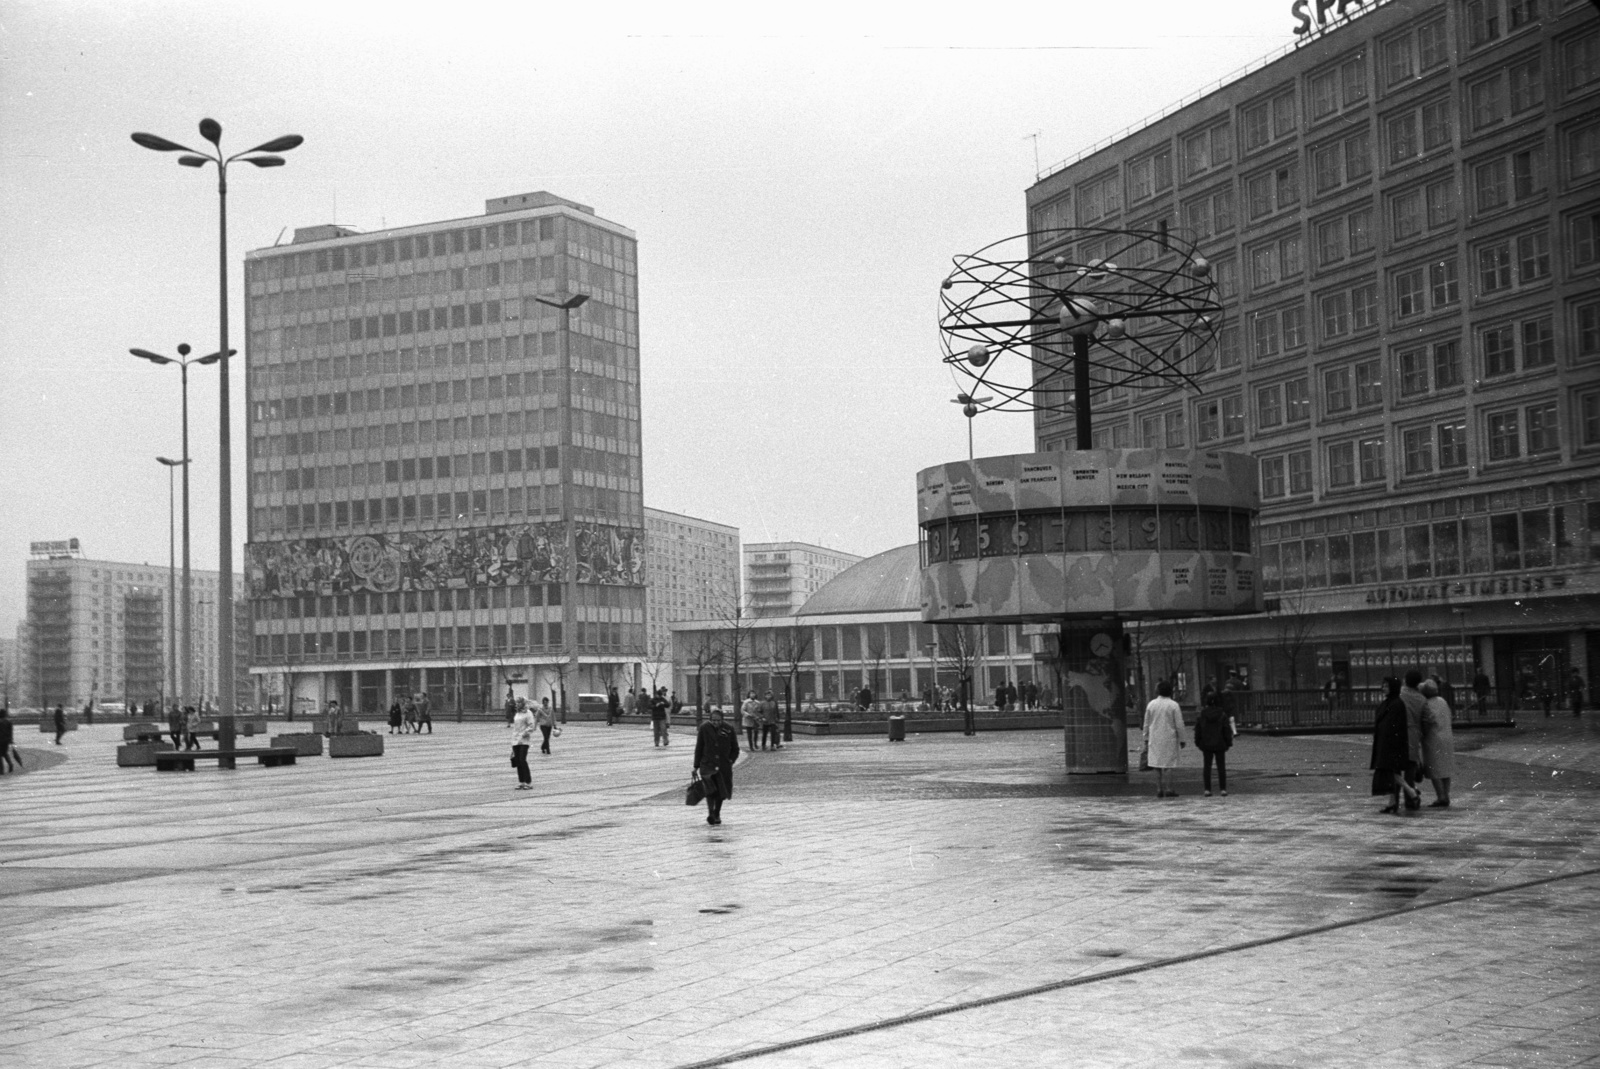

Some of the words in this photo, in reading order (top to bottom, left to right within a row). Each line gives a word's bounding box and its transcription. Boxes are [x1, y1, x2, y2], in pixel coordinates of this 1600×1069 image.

[933, 530, 941, 556] 3
[950, 527, 961, 552] 4
[978, 524, 990, 549] 5
[1012, 521, 1029, 547] 6
[1051, 518, 1072, 545] 7
[1099, 516, 1118, 545] 8
[1141, 516, 1159, 544] 9
[1175, 516, 1200, 543] 10
